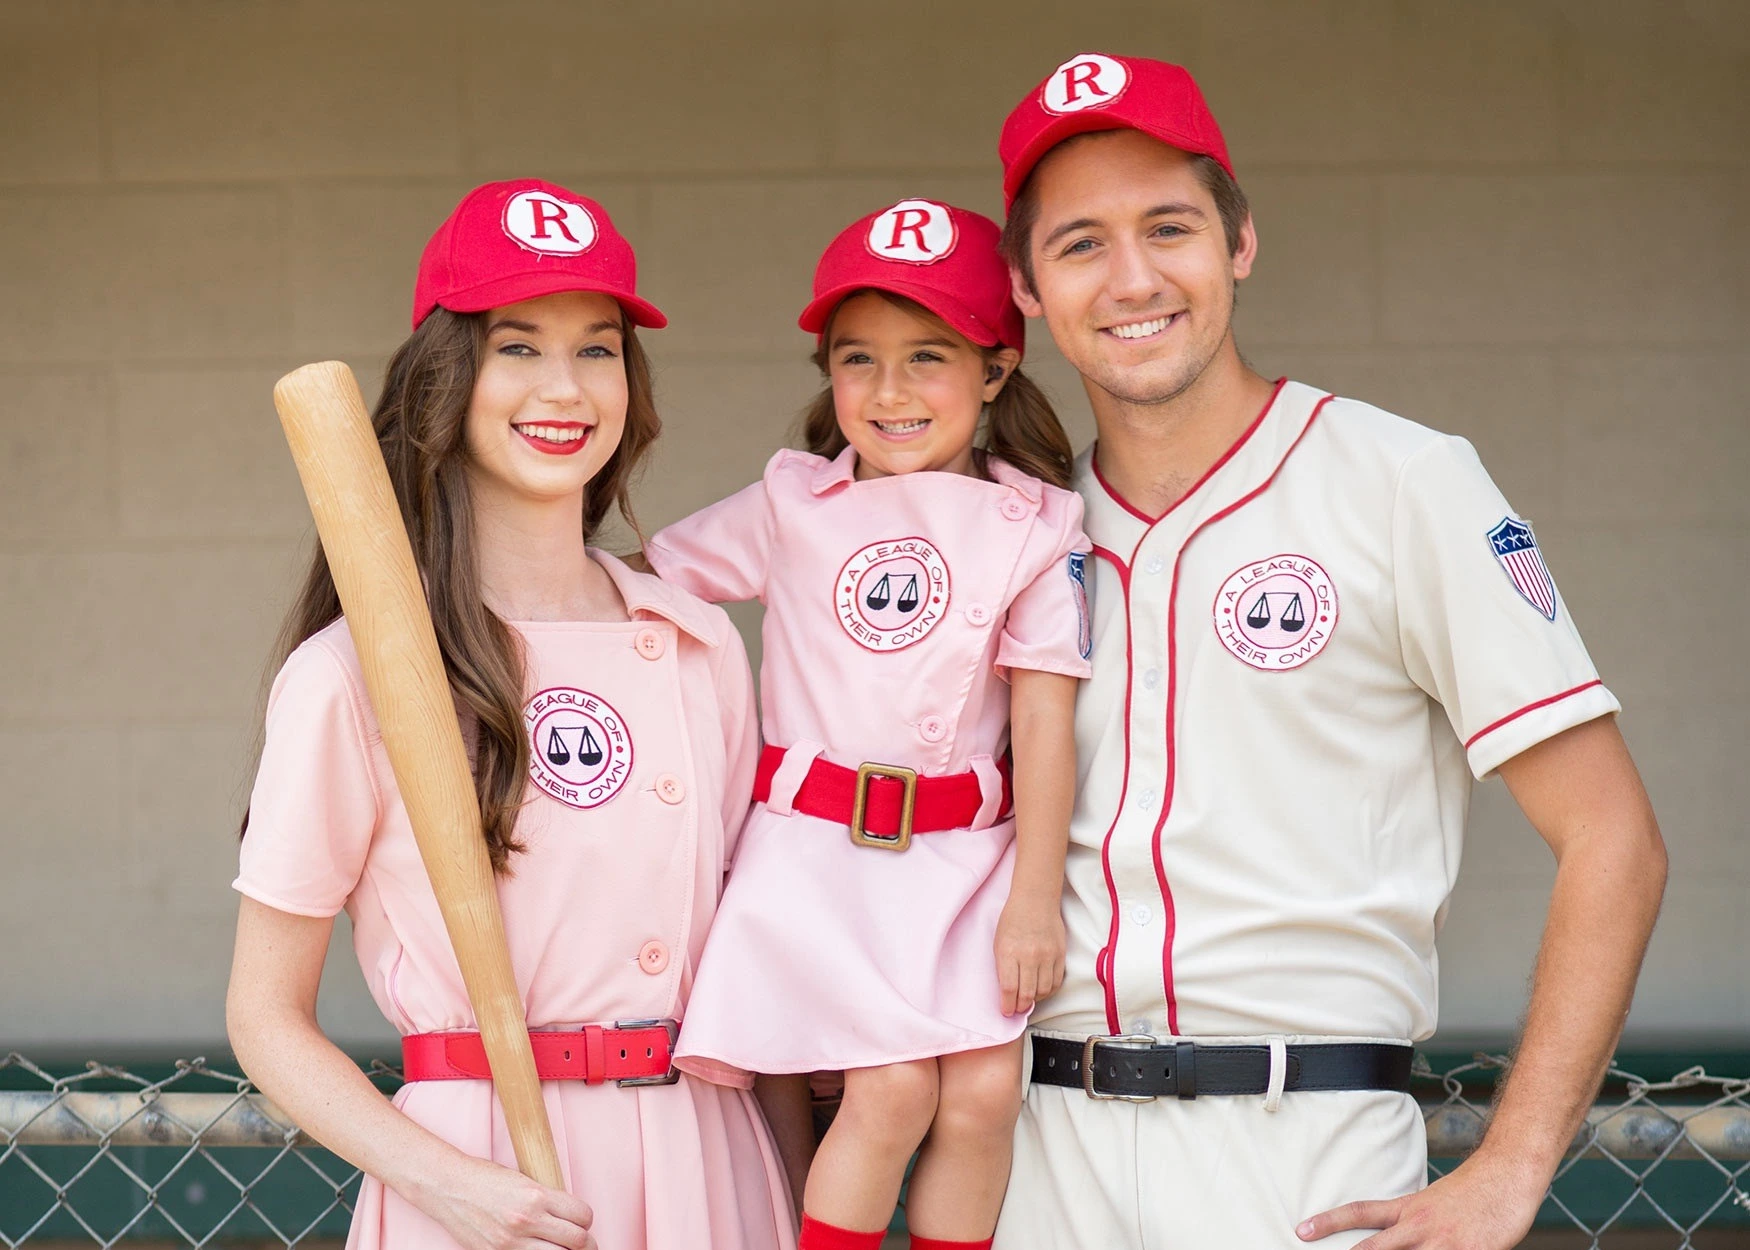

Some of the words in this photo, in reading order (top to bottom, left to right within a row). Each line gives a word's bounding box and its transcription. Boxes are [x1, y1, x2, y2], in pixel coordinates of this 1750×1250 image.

[1061, 61, 1109, 106] R
[525, 198, 580, 244] R
[884, 208, 932, 253] R
[848, 569, 861, 582] A
[864, 542, 933, 563] LEAGUE
[931, 566, 943, 593] OF
[1225, 590, 1238, 602] A
[1240, 560, 1317, 584] LEAGUE
[1317, 584, 1330, 611] OF
[841, 598, 882, 646] THEIR
[891, 610, 936, 645] OWN
[1221, 619, 1267, 664] THEIR
[1278, 630, 1324, 664] OWN
[525, 693, 599, 722] LEAGUE
[604, 716, 623, 743] OF
[530, 759, 579, 802] THEIR
[588, 759, 626, 800] OWN
